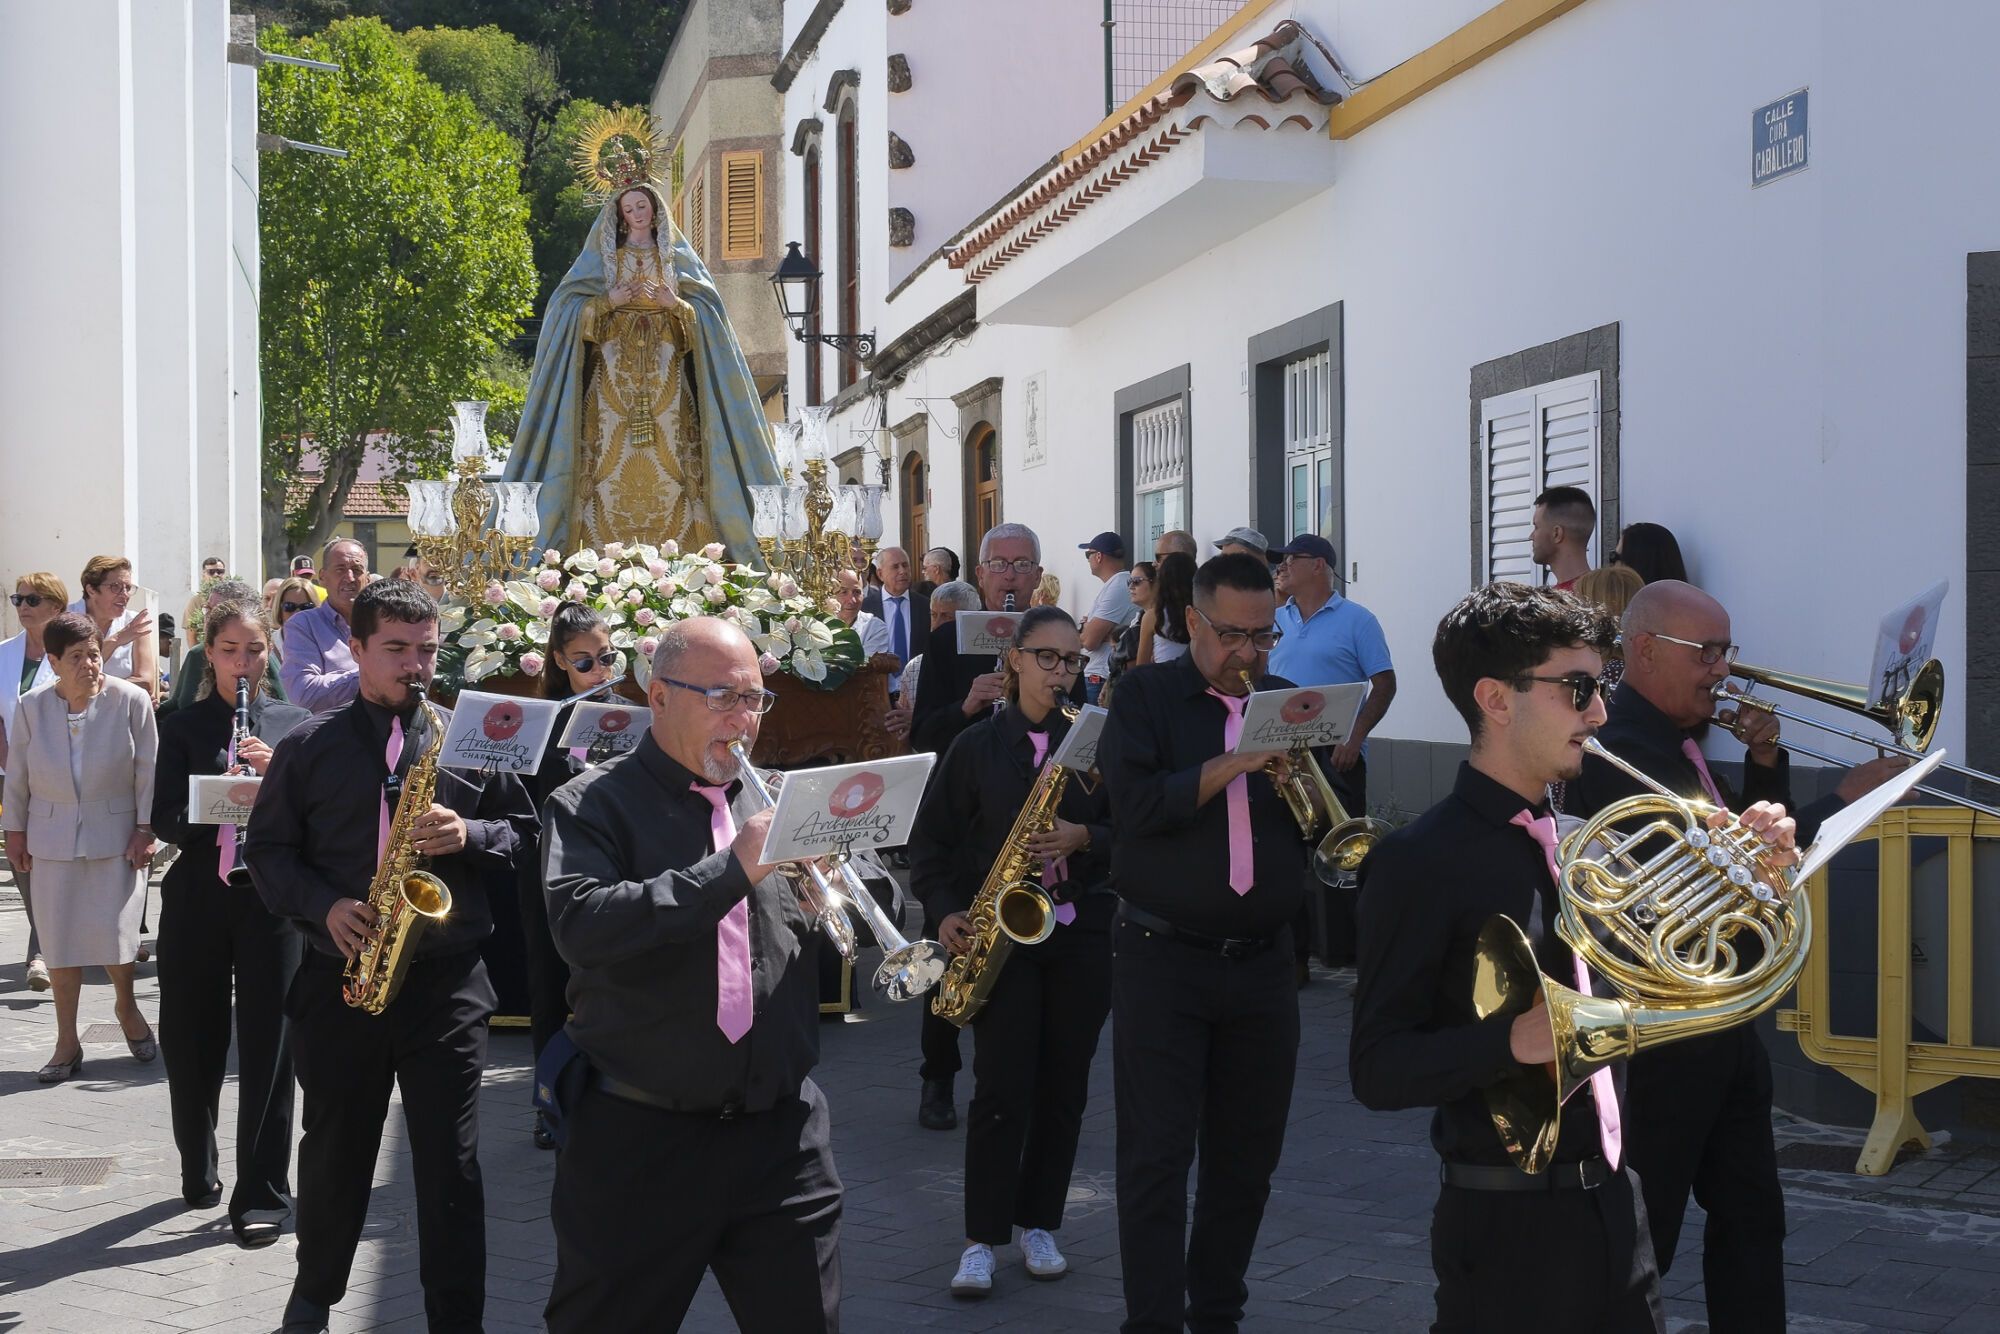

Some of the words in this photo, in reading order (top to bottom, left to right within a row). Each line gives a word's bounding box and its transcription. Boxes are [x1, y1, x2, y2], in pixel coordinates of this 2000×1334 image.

[1764, 100, 1794, 125] CALLE
[1769, 119, 1788, 144] CURA
[1755, 134, 1804, 179] CABALLERO
[803, 831, 869, 846] CHARANGA
